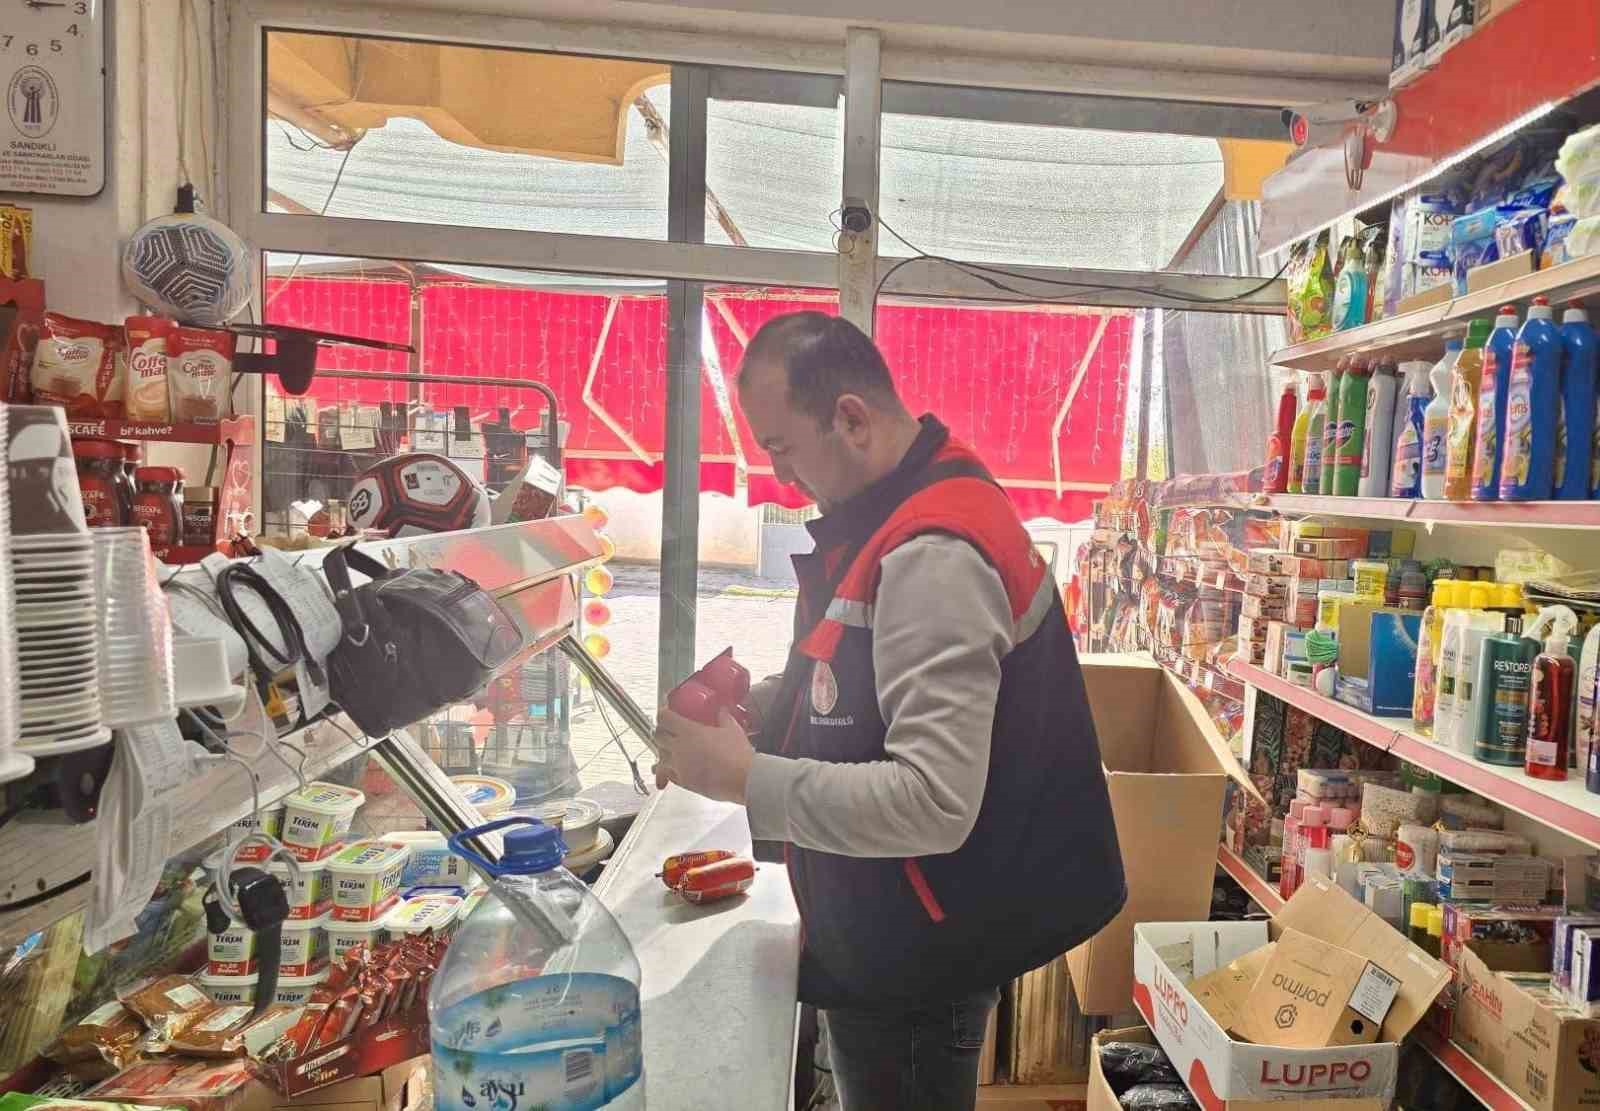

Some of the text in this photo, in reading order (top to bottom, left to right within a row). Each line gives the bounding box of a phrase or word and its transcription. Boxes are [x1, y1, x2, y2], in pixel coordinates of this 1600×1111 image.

[74, 1, 87, 15] 3
[66, 23, 79, 37] 4
[2, 35, 14, 47] 7
[50, 39, 62, 52] 5
[26, 44, 38, 56] 6
[131, 351, 167, 371] Coffe
[68, 421, 105, 436] SCAFÉ
[1260, 1059, 1371, 1085] LUPPO
